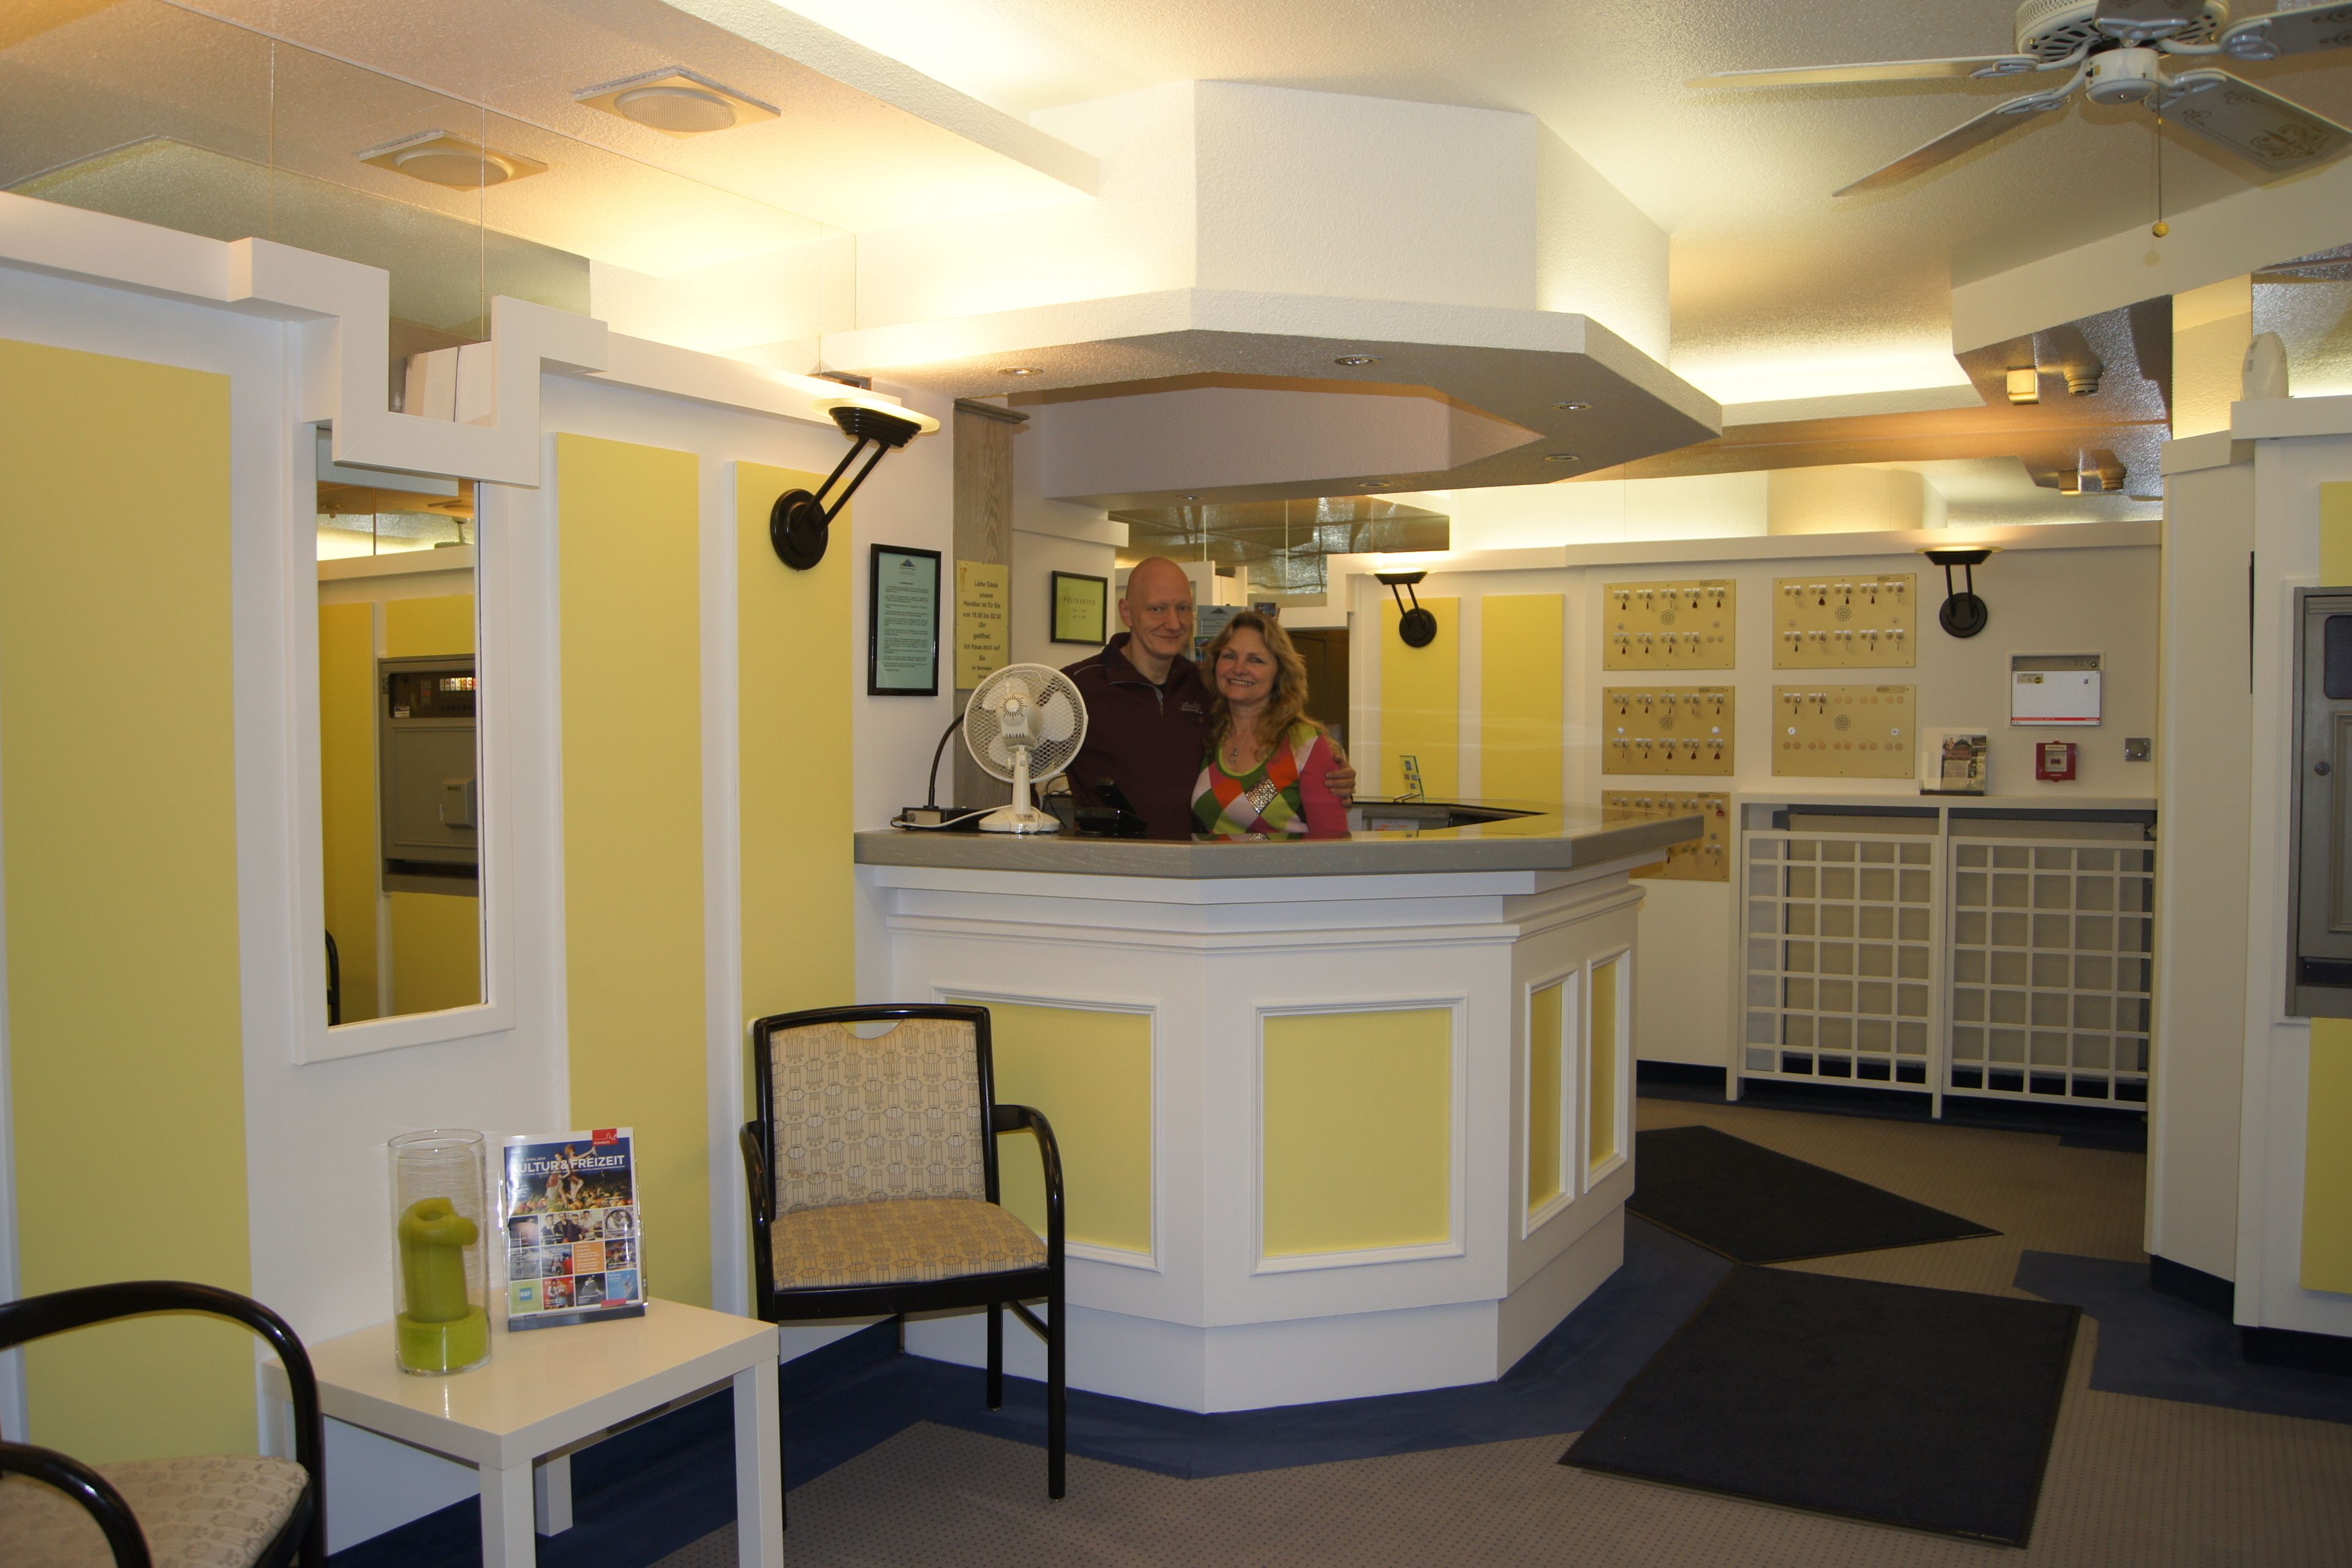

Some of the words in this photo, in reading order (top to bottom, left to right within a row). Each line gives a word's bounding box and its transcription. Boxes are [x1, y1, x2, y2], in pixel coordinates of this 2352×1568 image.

[1063, 597, 1096, 605] POSTKARTEN
[514, 1160, 559, 1174] ULTUR
[570, 1155, 625, 1169] FREIZEIT
